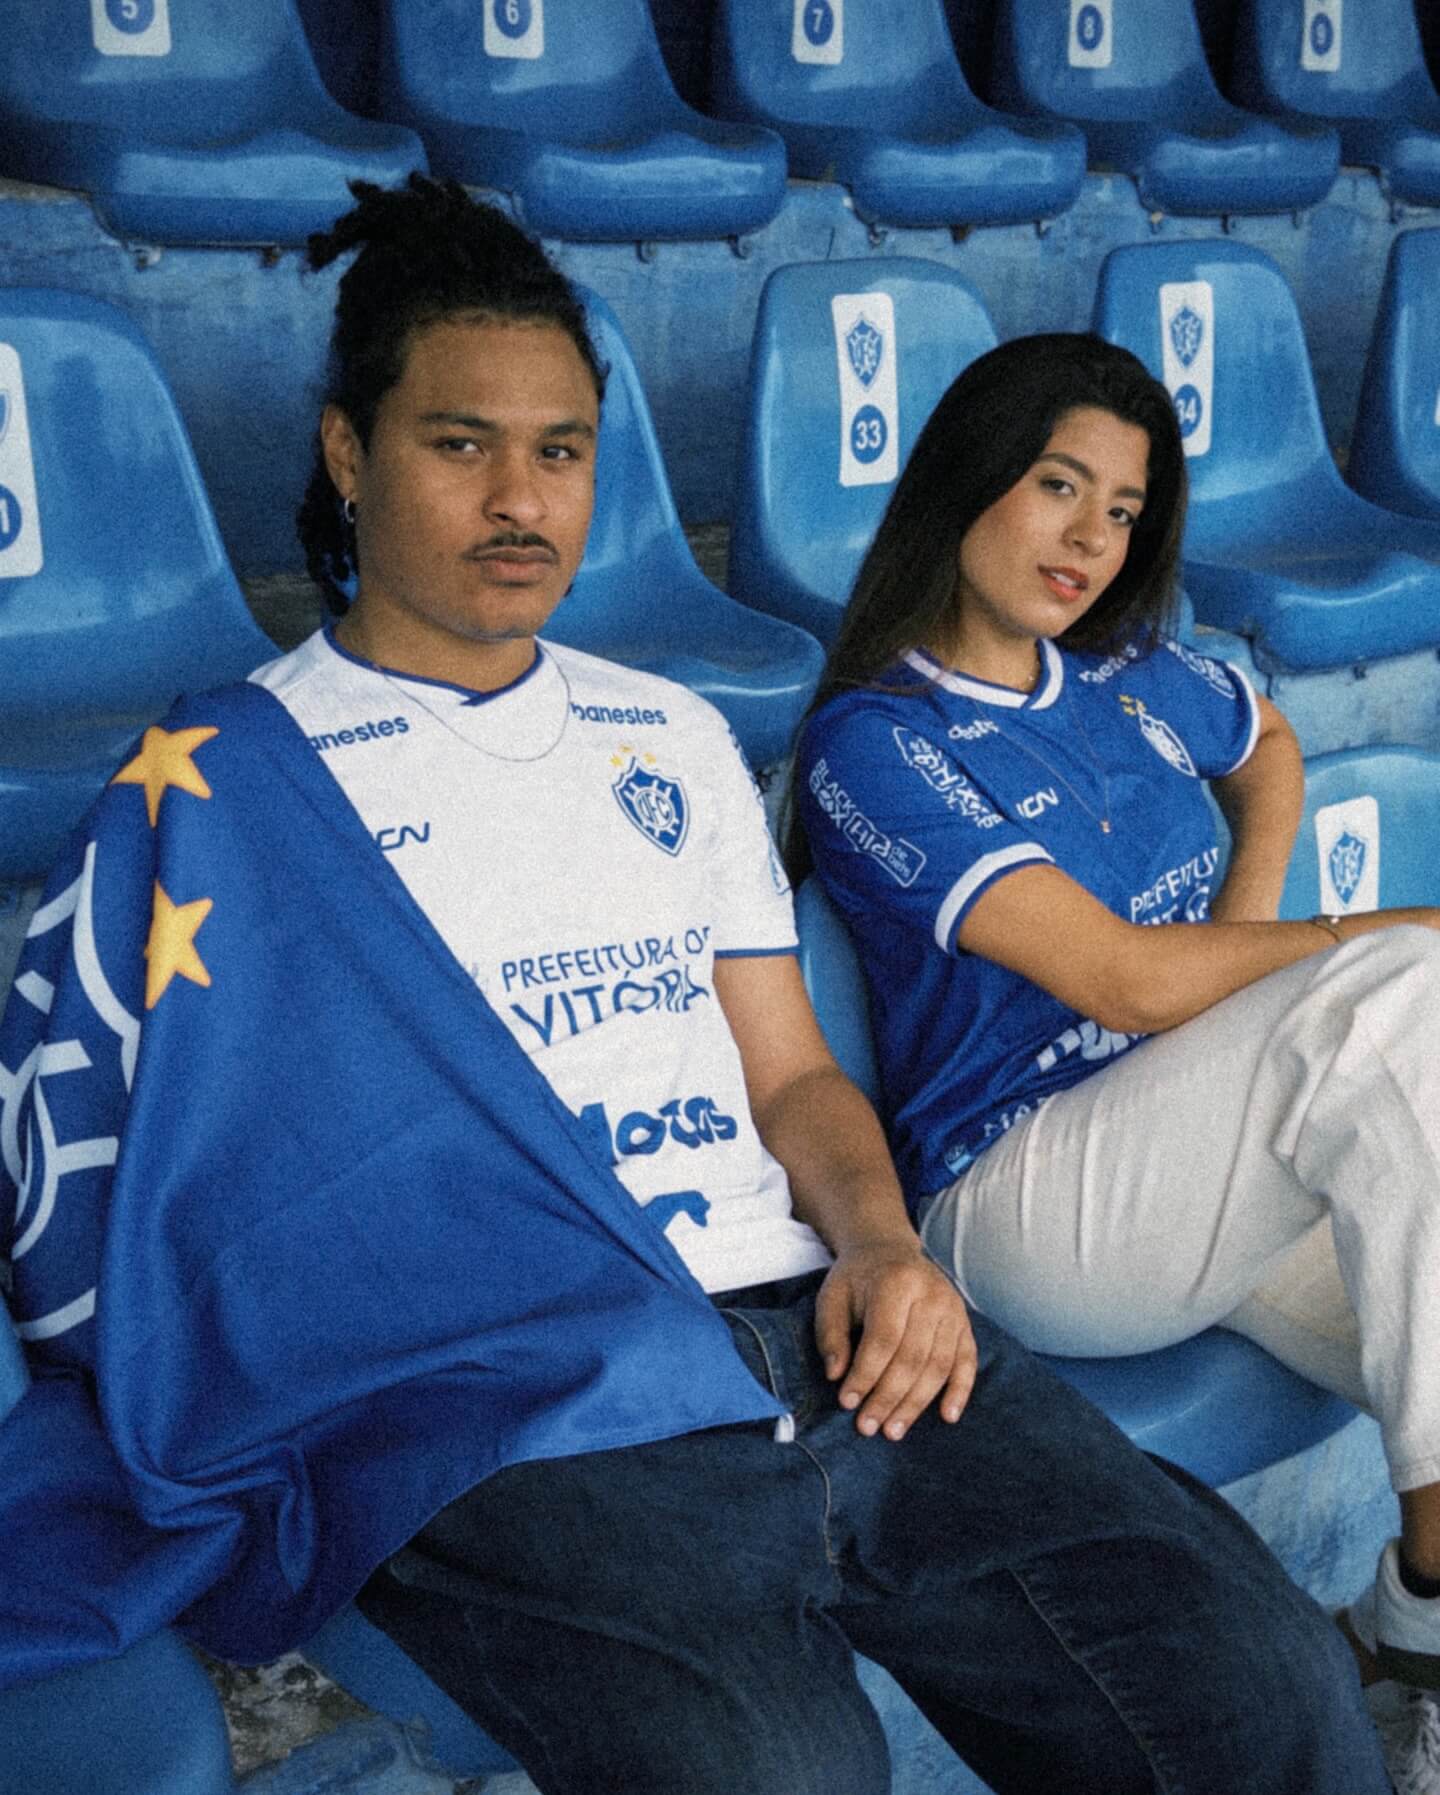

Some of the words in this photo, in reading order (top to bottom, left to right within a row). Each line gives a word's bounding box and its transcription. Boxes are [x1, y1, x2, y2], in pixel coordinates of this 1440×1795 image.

[506, 0, 519, 25] 6
[813, 8, 824, 32] 7
[855, 419, 882, 449] 33
[308, 716, 409, 751] anestes
[376, 821, 430, 851] CN
[501, 936, 679, 993] PREFEITURA
